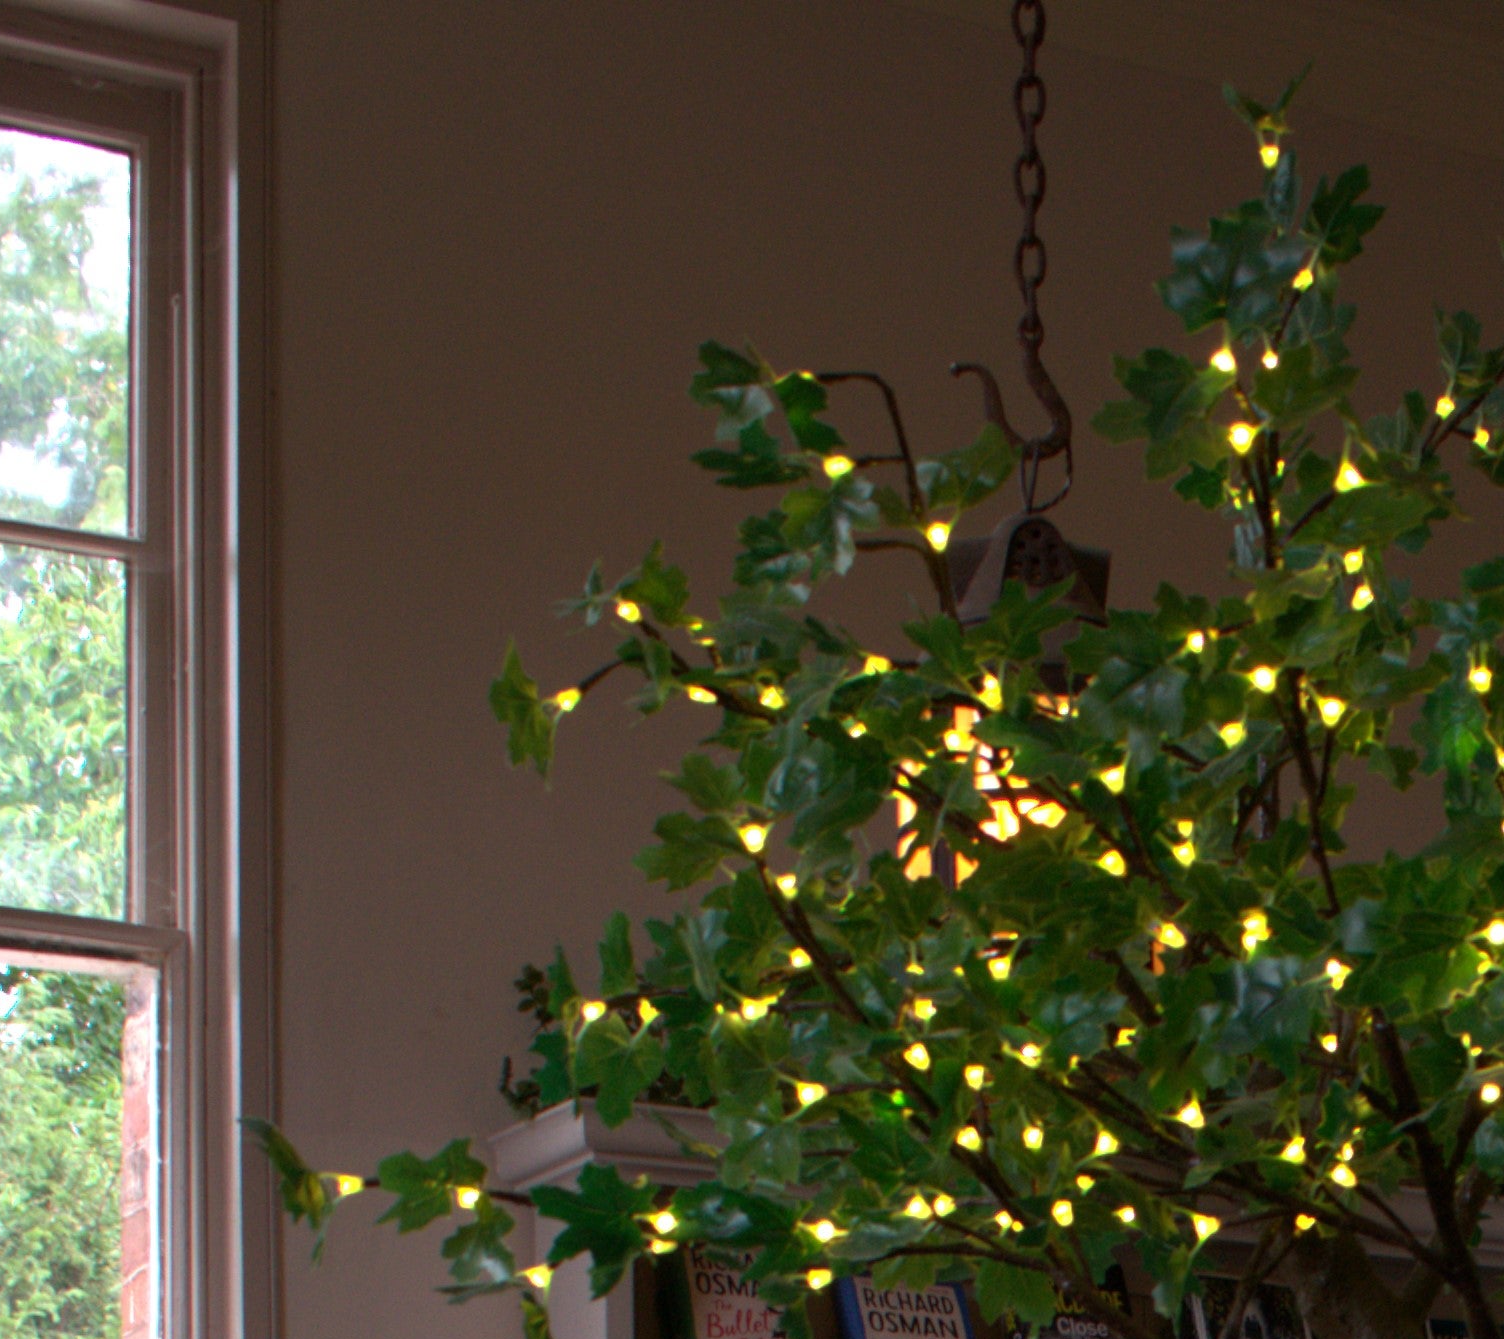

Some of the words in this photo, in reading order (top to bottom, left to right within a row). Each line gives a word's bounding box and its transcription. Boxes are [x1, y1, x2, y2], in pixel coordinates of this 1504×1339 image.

[863, 1288, 955, 1316] RICHARD
[706, 1311, 771, 1339] Bullet
[868, 1311, 959, 1339] OSMAN
[1056, 1315, 1110, 1338] Close
